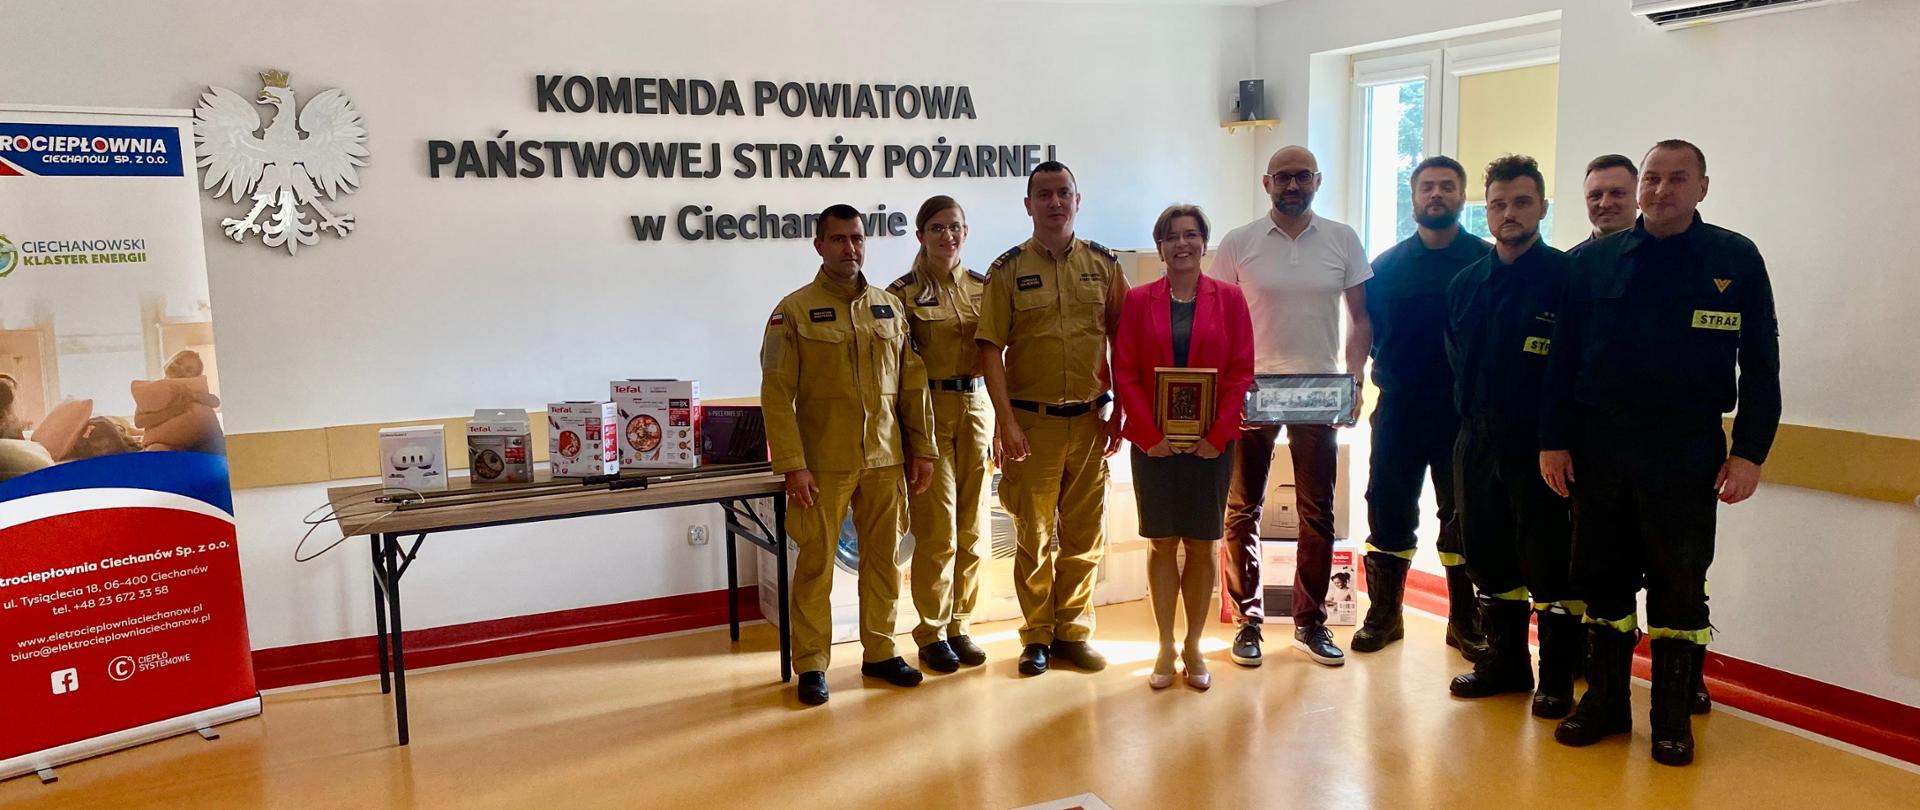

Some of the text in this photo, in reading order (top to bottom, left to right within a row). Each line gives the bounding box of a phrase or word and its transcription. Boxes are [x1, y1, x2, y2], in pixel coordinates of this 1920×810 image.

[536, 75, 977, 120] KOMENDA POWIATOWA
[42, 155, 109, 164] CIECHANÓW
[114, 156, 133, 164] SP.
[146, 156, 168, 164] O.O.
[428, 129, 722, 179] PAŃSTWOWEJ
[733, 135, 874, 179] STRAŻY
[630, 215, 666, 241] w
[21, 238, 146, 253] CIECHANOWSKI
[23, 252, 147, 266] KLASTER ENERGII
[614, 385, 642, 393] Tefal
[100, 549, 173, 569] Ciechanów
[175, 546, 196, 558] Sp.
[198, 544, 206, 553] z
[208, 541, 230, 551] o.o.
[3, 599, 19, 609] ul.
[20, 588, 84, 607] Tysiąclecia
[104, 575, 148, 591] 06-400
[151, 565, 209, 582] Ciechanów
[52, 585, 169, 615] tel. +48 23 672 33 58
[10, 613, 211, 662] biuro@elektrocieplowniaciechanow.pl
[138, 651, 168, 664] CIEPŁO
[139, 653, 191, 672] SYSTEMOWE
